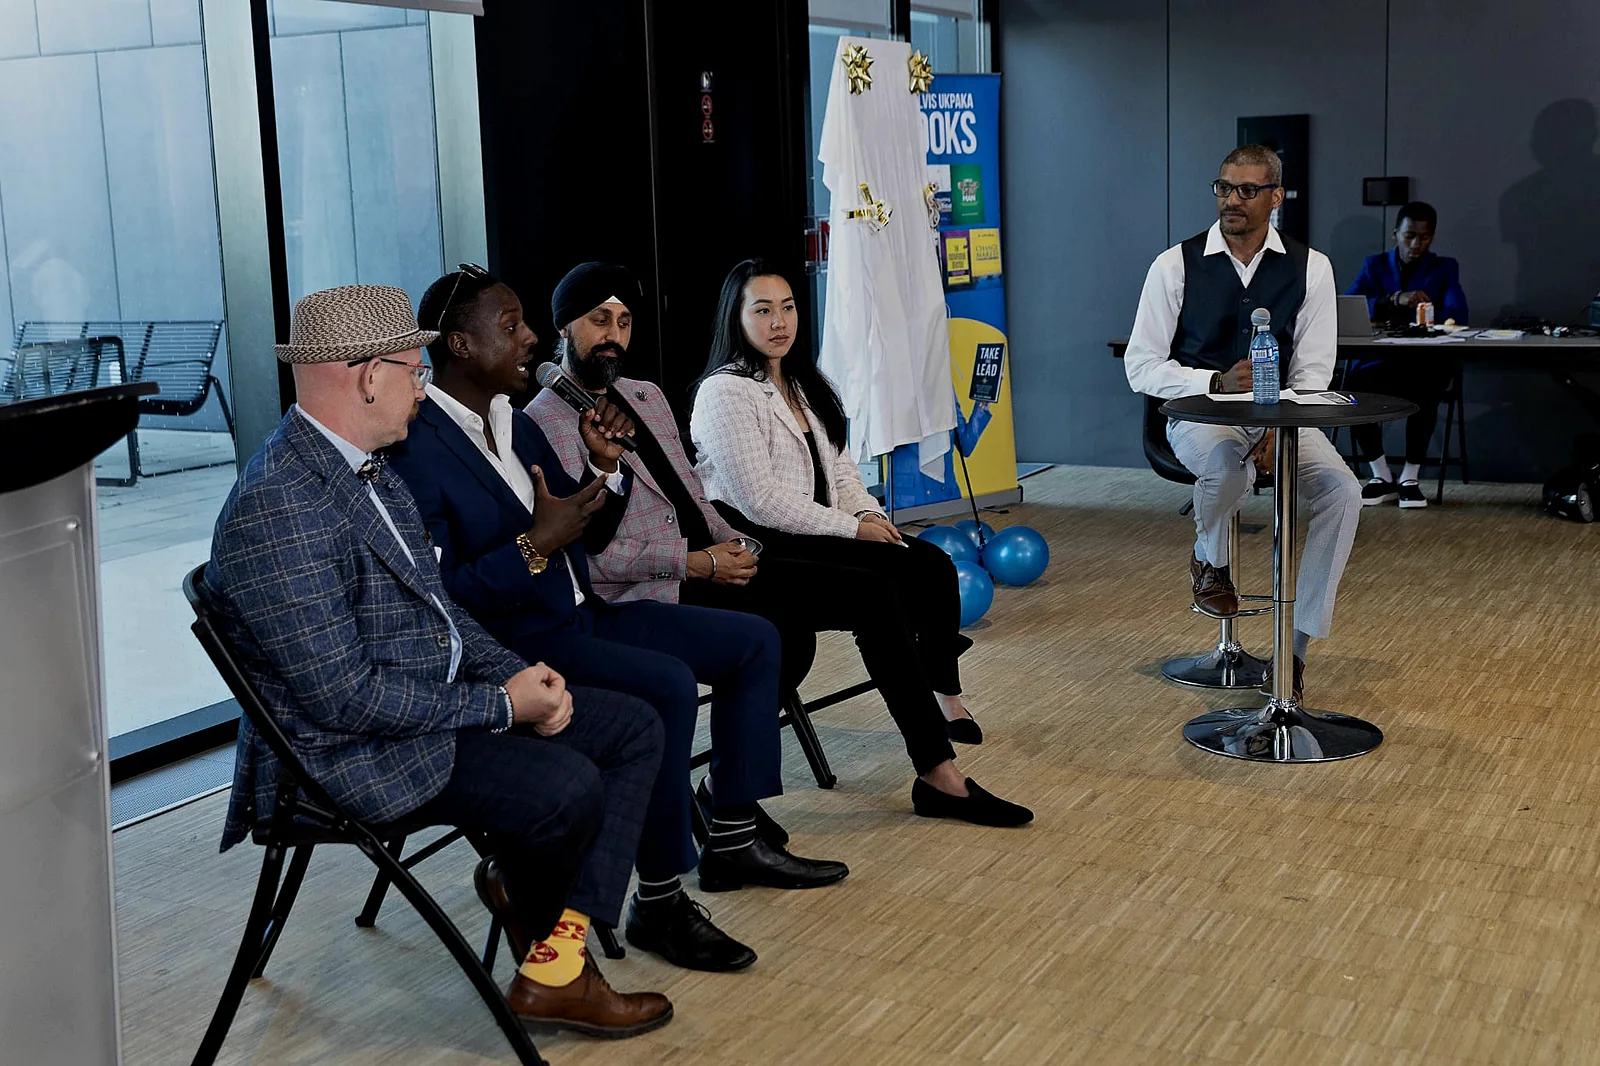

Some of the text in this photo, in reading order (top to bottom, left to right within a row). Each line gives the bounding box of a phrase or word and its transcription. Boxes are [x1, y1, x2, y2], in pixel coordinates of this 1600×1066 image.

[938, 92, 974, 109] UKPAKA
[919, 110, 977, 154] OOKS
[980, 347, 1000, 359] TAKE
[976, 363, 998, 376] LEAD
